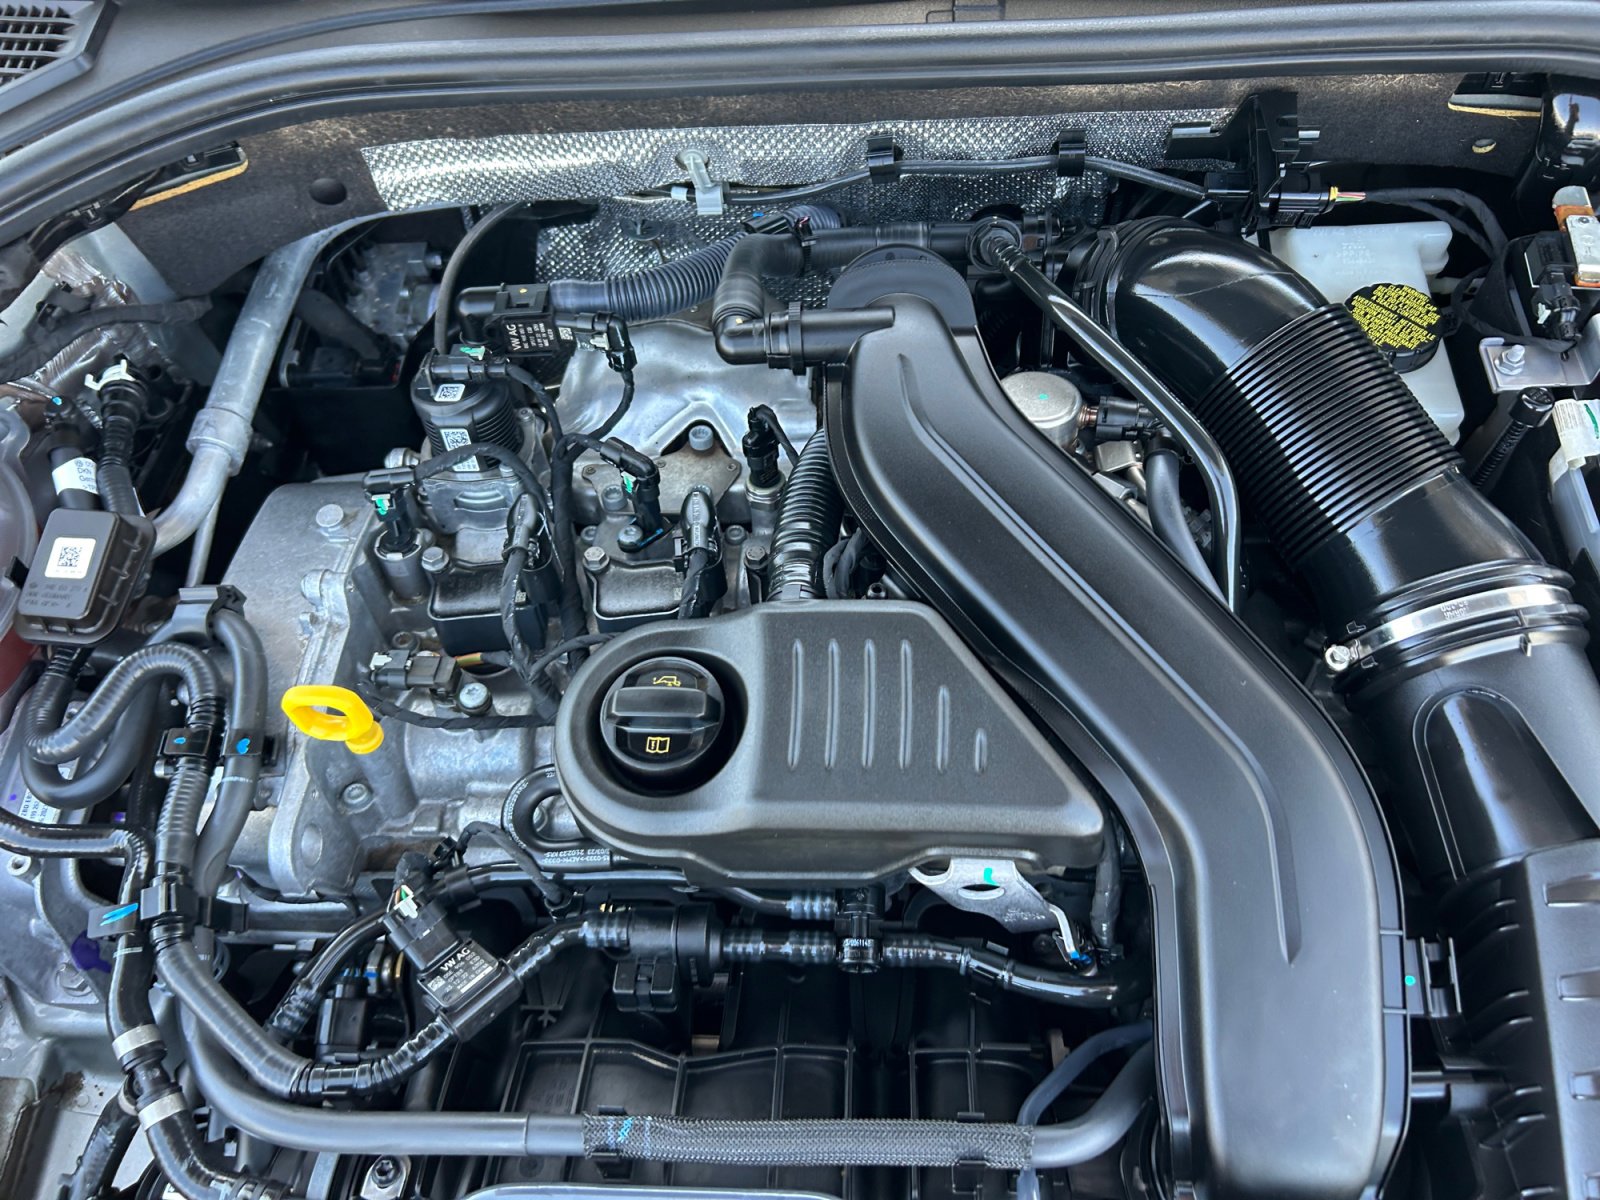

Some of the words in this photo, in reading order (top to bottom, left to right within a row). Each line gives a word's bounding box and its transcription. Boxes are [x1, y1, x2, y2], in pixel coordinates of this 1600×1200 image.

[1376, 298, 1398, 311] SEALED
[1377, 285, 1399, 299] BEFORE
[1427, 311, 1441, 320] USE
[1387, 297, 1400, 305] DOT
[1402, 305, 1420, 316] FLUID
[1388, 285, 1406, 296] CLEAN
[1405, 294, 1425, 306] FILLER
[1425, 304, 1437, 312] CAP
[1377, 314, 1396, 325] AVANT
[506, 325, 518, 335] AG
[510, 338, 521, 350] VW
[440, 957, 456, 971] VW
[456, 947, 470, 960] AG
